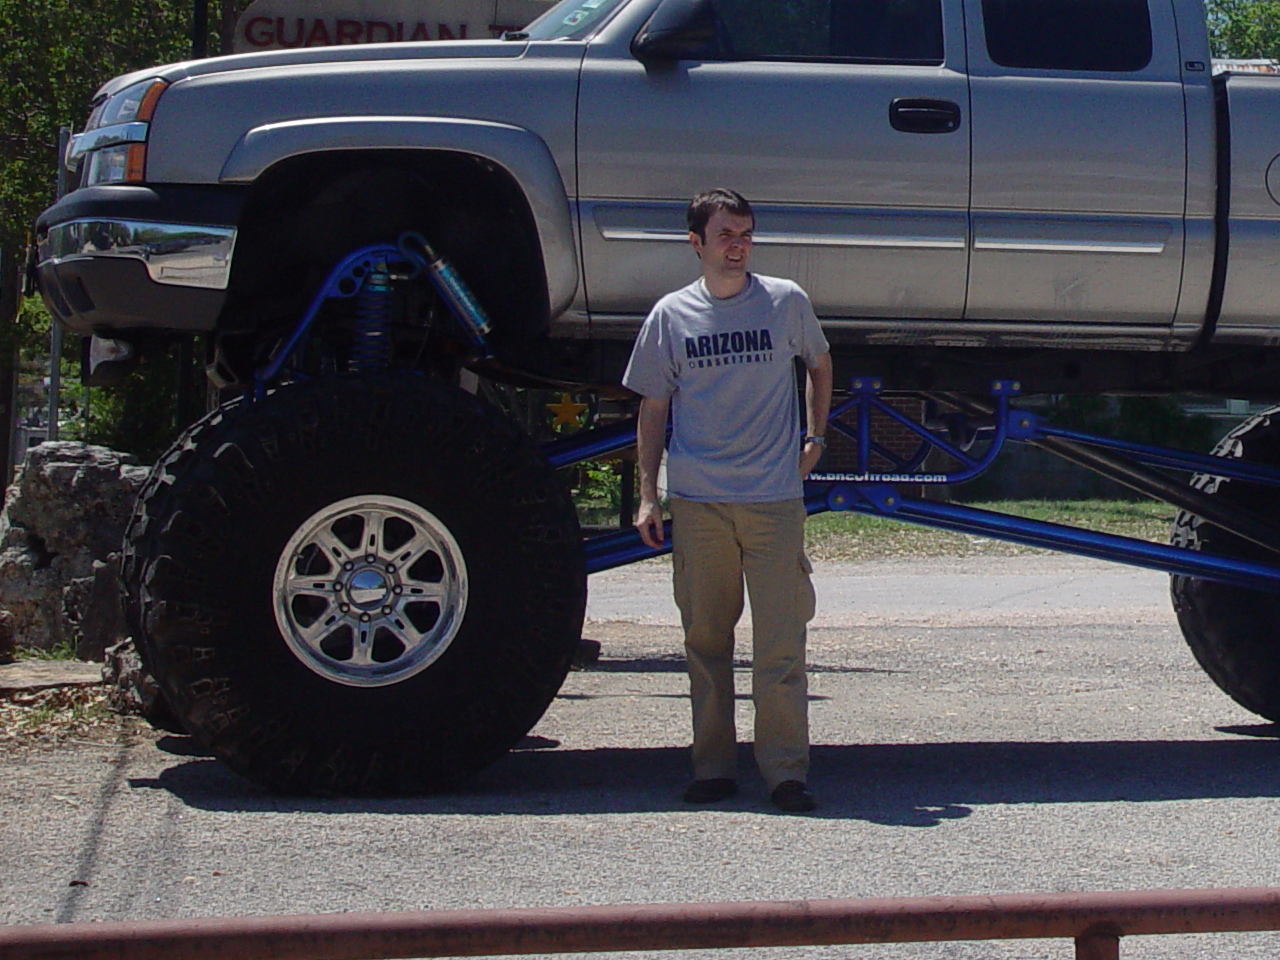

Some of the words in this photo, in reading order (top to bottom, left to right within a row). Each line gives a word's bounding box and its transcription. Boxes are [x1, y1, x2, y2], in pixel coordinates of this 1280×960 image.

[244, 16, 467, 48] GUARDIAN
[685, 329, 773, 359] ARIZONA
[698, 352, 773, 368] BASKETBALL
